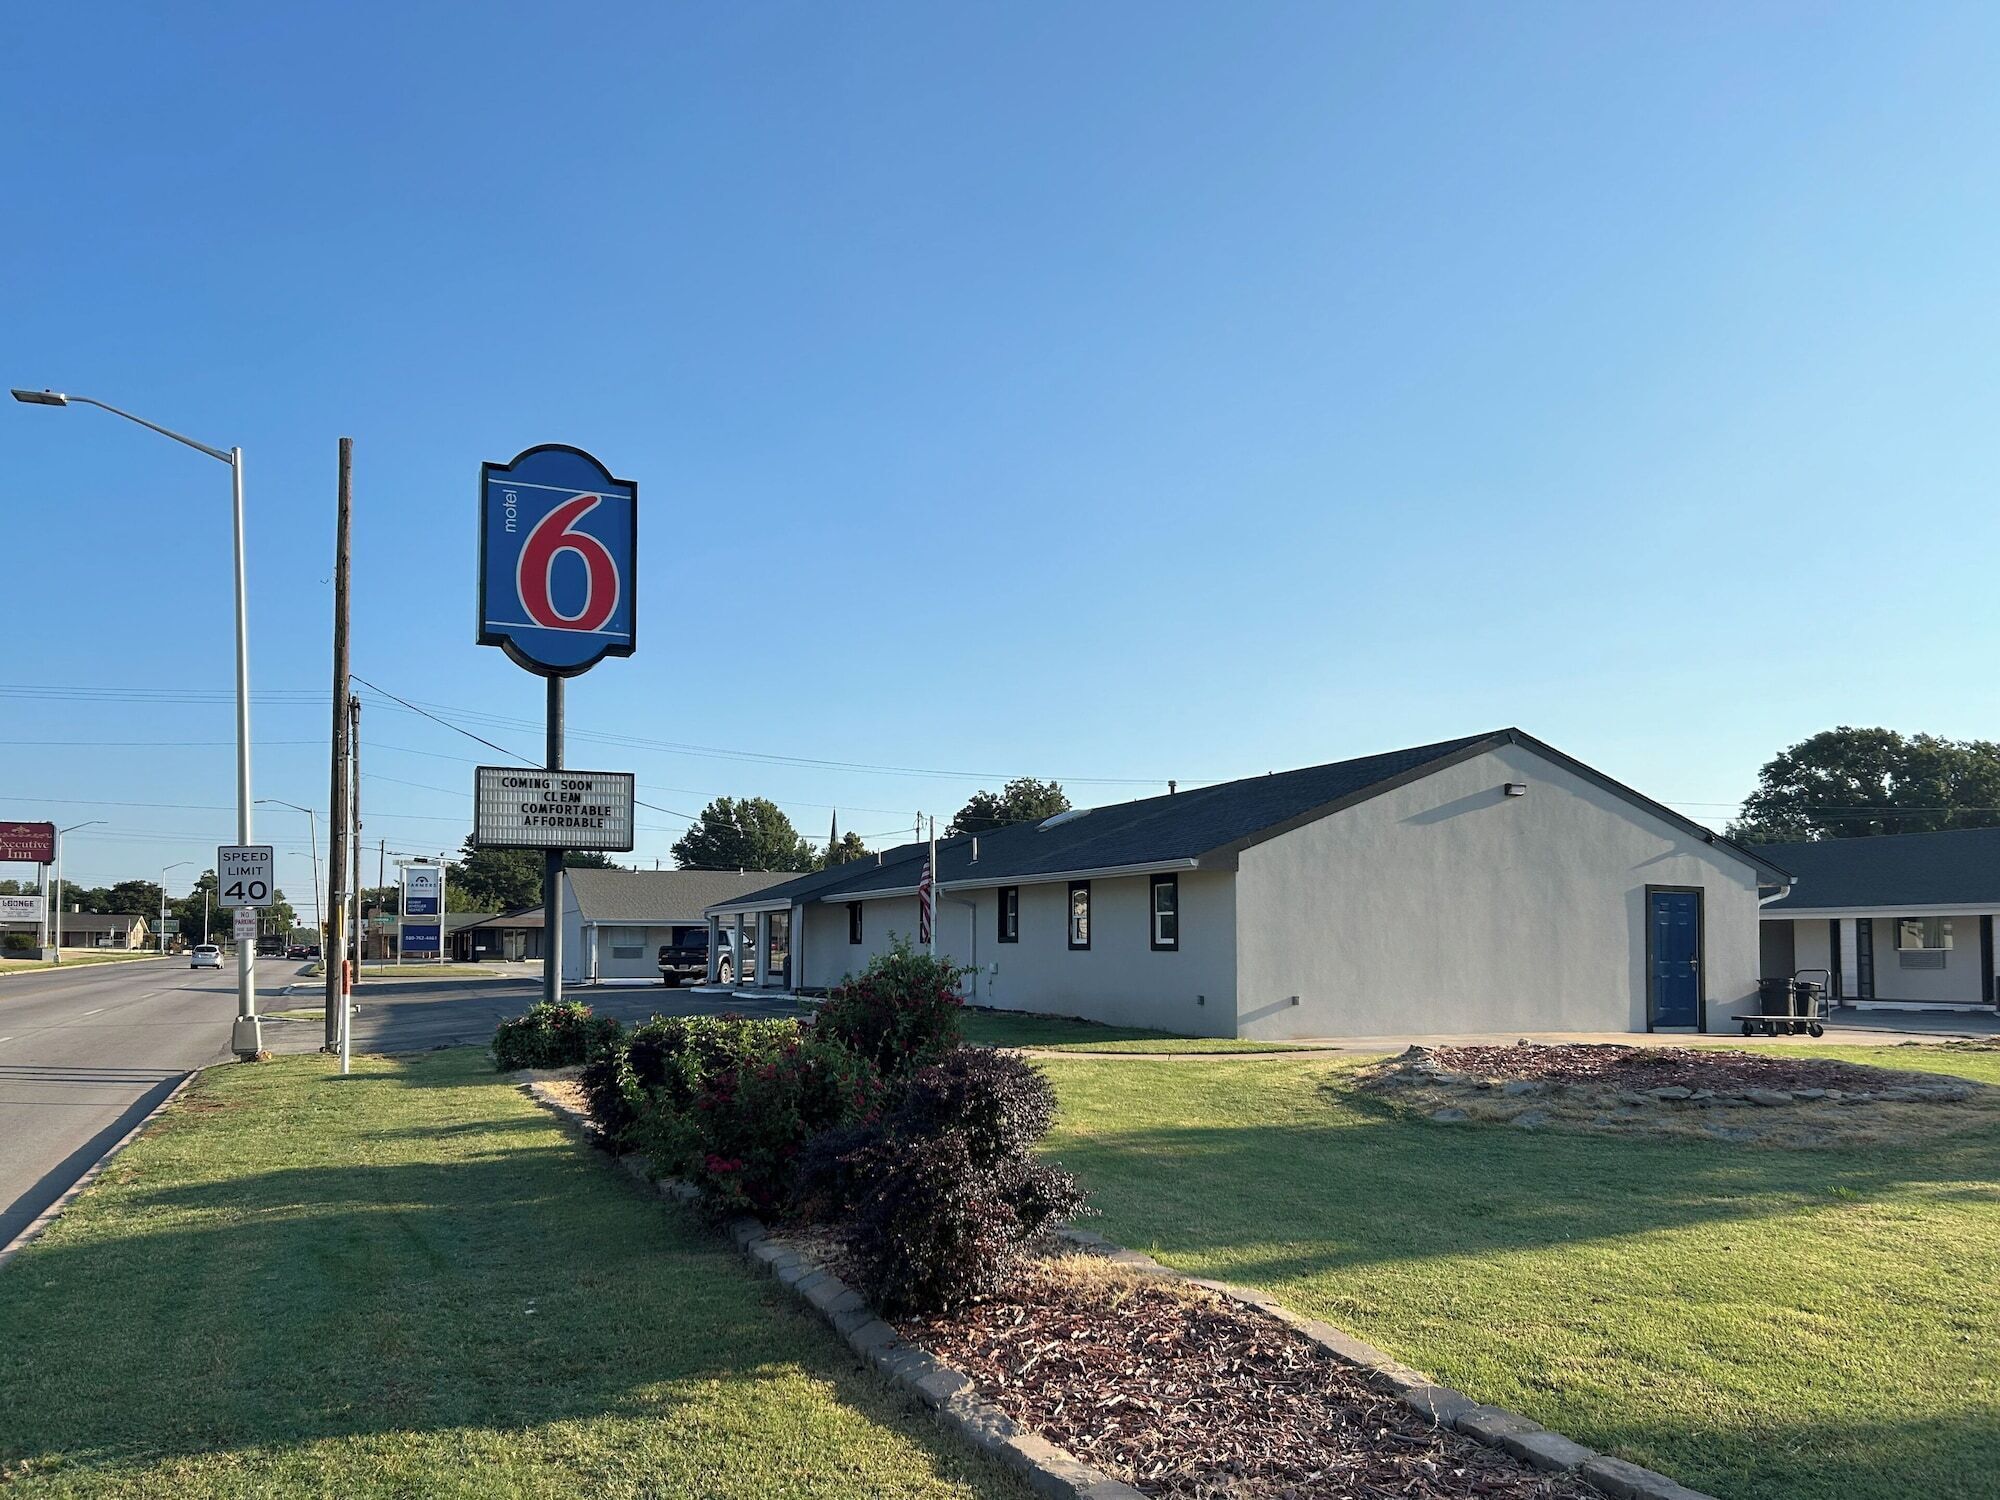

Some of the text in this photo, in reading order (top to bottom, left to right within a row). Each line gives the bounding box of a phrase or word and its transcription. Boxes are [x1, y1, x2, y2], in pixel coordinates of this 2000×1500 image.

[502, 489, 517, 533] motel
[516, 493, 620, 632] 6
[502, 777, 593, 791] COMING SOON
[543, 791, 581, 803] CLEAN
[521, 803, 611, 816] COMFORTABLE
[524, 816, 604, 828] AFFORDABLE
[8, 848, 32, 859] Inn
[223, 852, 269, 862] SPEED
[228, 866, 263, 876] LIMIT
[224, 881, 267, 900] 40
